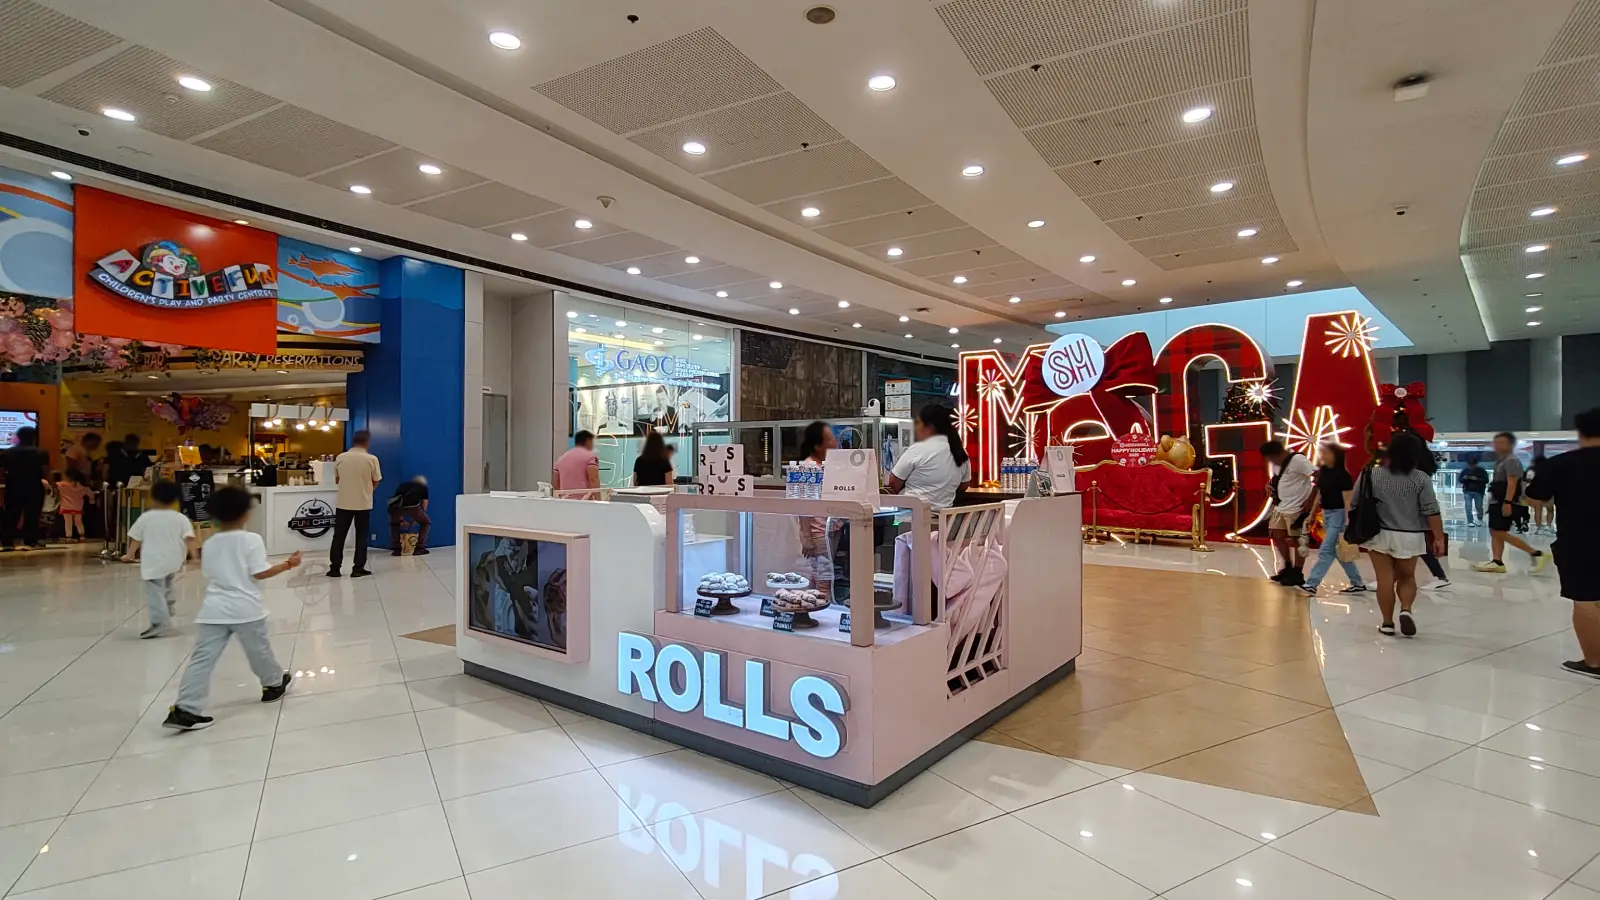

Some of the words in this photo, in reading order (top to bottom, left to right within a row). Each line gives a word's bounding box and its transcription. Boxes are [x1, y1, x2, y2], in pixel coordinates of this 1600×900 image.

[98, 272, 156, 305] CHILDREN'S
[159, 298, 181, 308] PLAY
[185, 297, 204, 308] AND
[208, 293, 234, 305] PARTY
[238, 288, 273, 300] CENTRES
[266, 353, 359, 367] RESERVATIONS
[614, 349, 675, 376] GAOC
[291, 520, 310, 528] FUN
[618, 631, 846, 758] ROLLS
